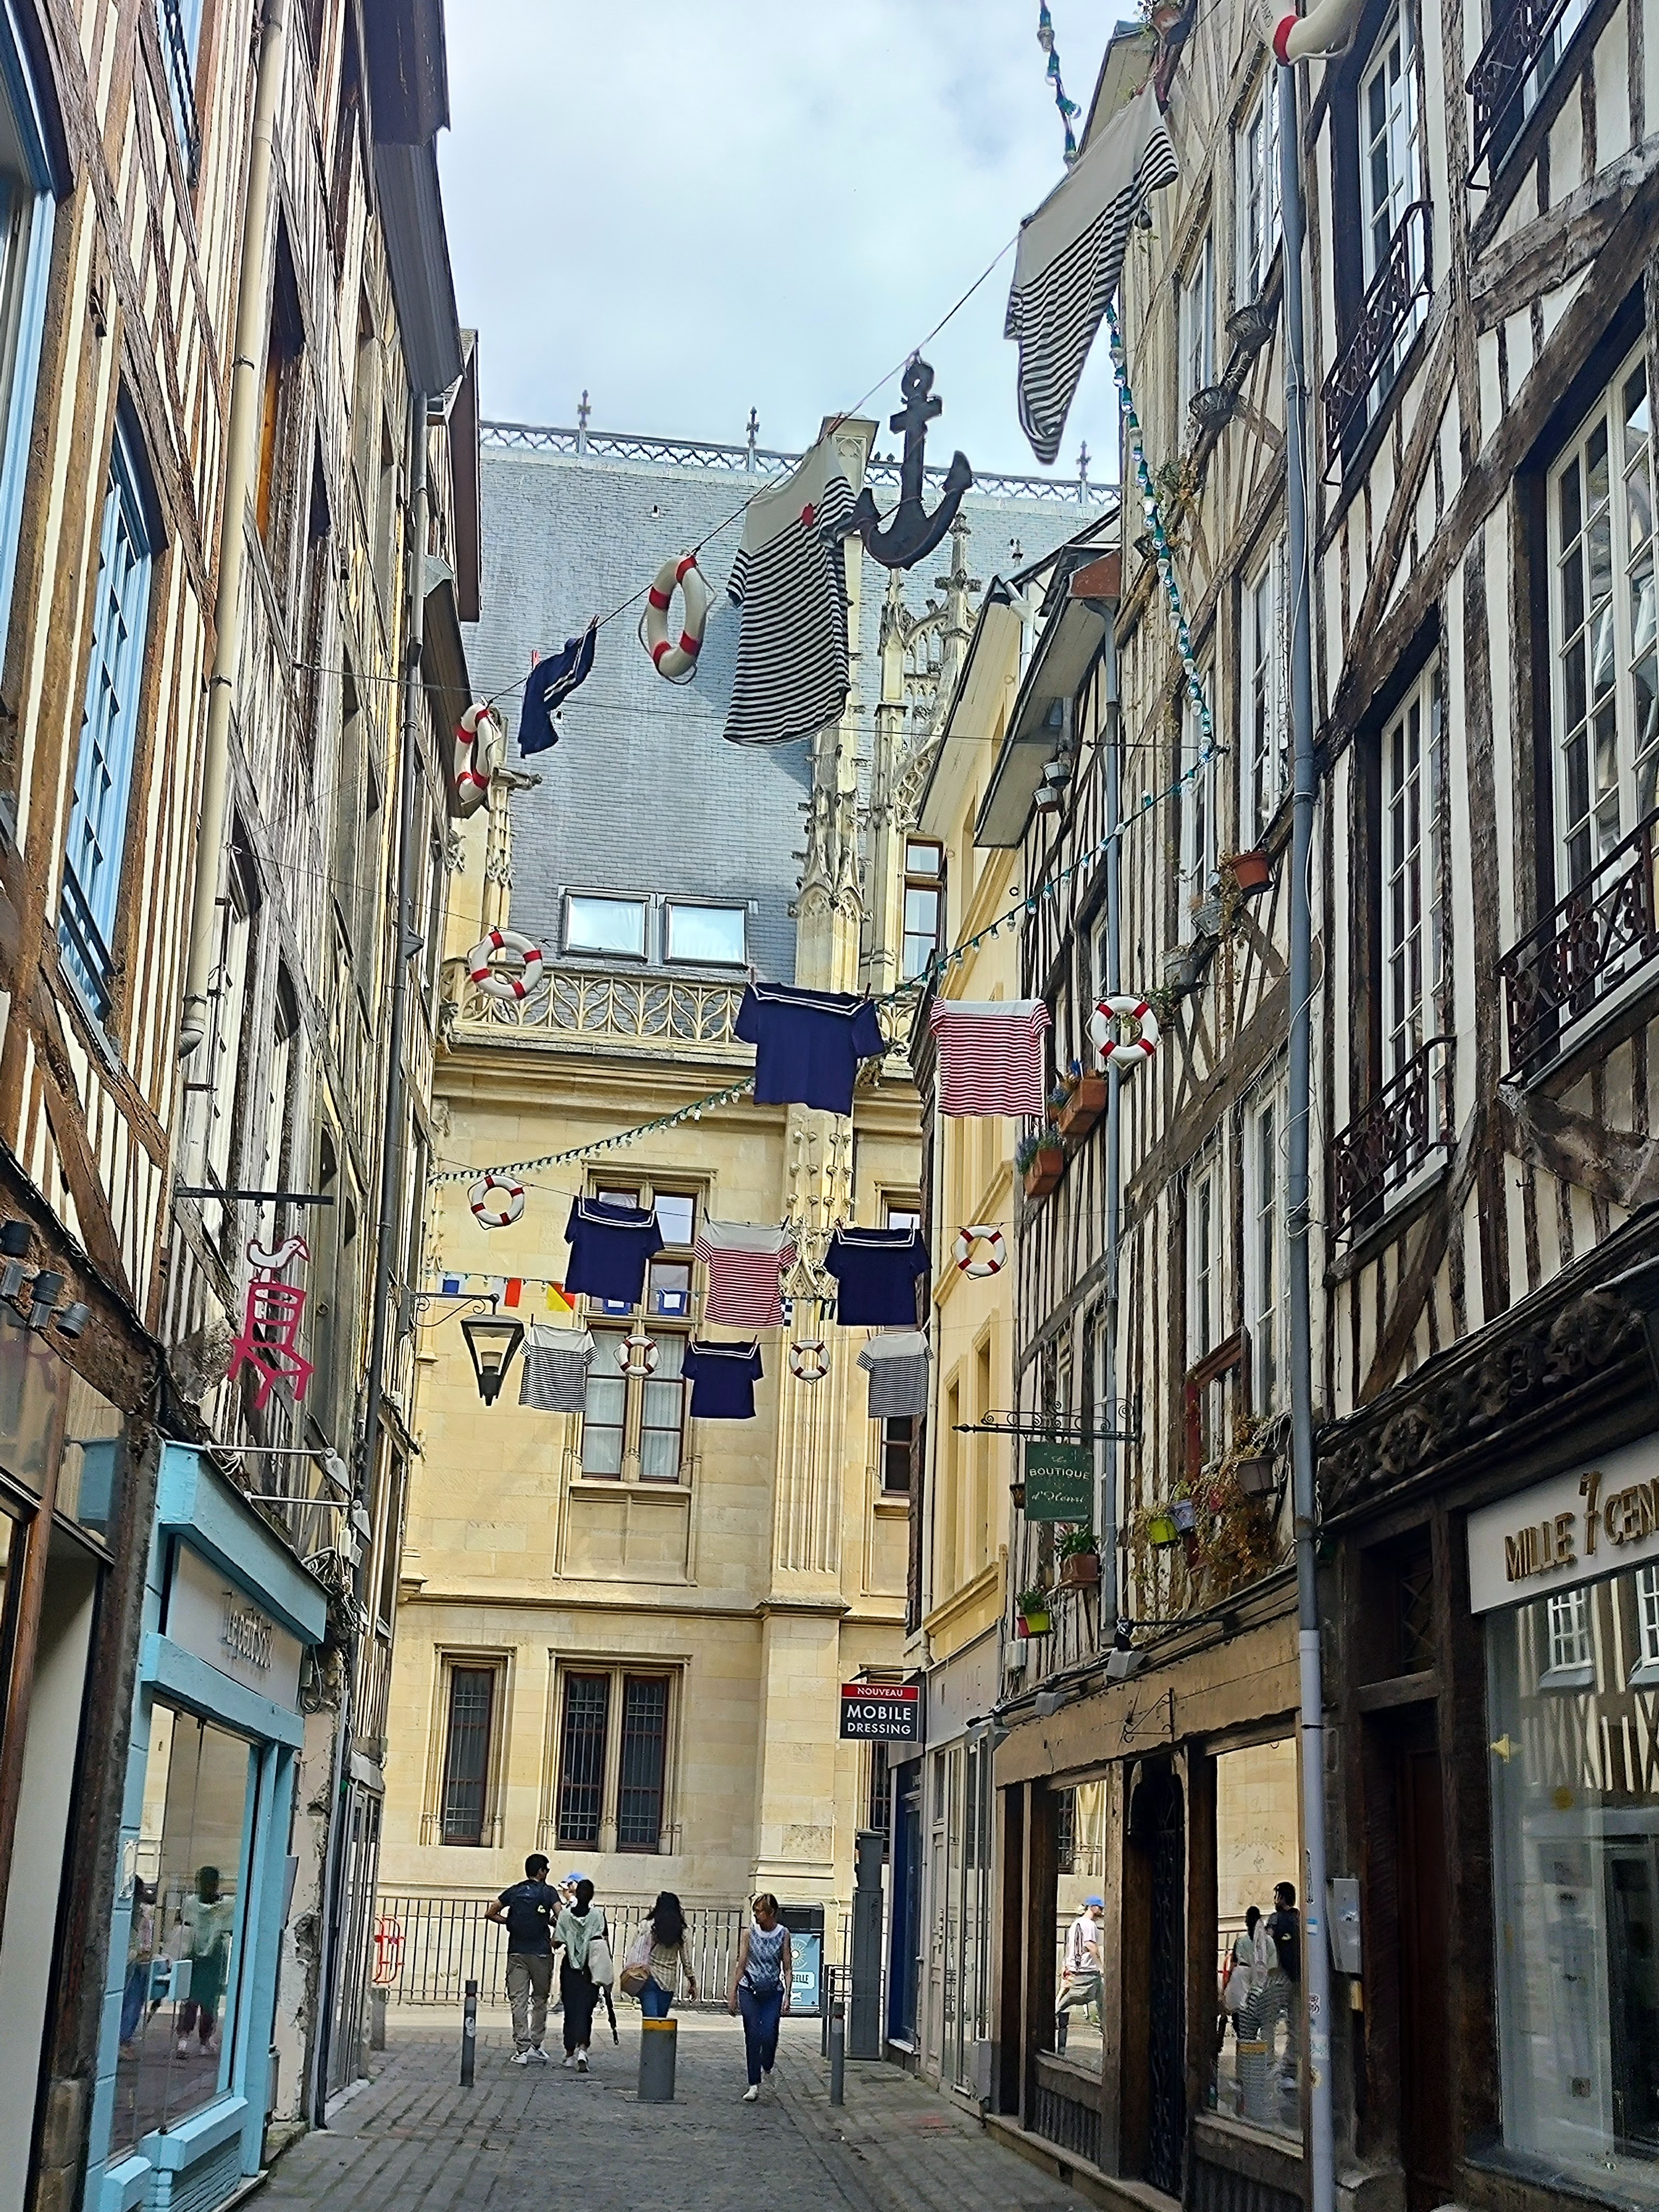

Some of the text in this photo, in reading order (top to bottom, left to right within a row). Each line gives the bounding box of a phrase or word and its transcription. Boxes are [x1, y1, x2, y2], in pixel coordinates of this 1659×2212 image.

[1029, 1467, 1090, 1481] BOUTIQUE
[1504, 1512, 1576, 1582] MILLE
[857, 1687, 903, 1697] NOUVEAU
[846, 1704, 912, 1721] MOBILE
[847, 1722, 912, 1735] DRESSING
